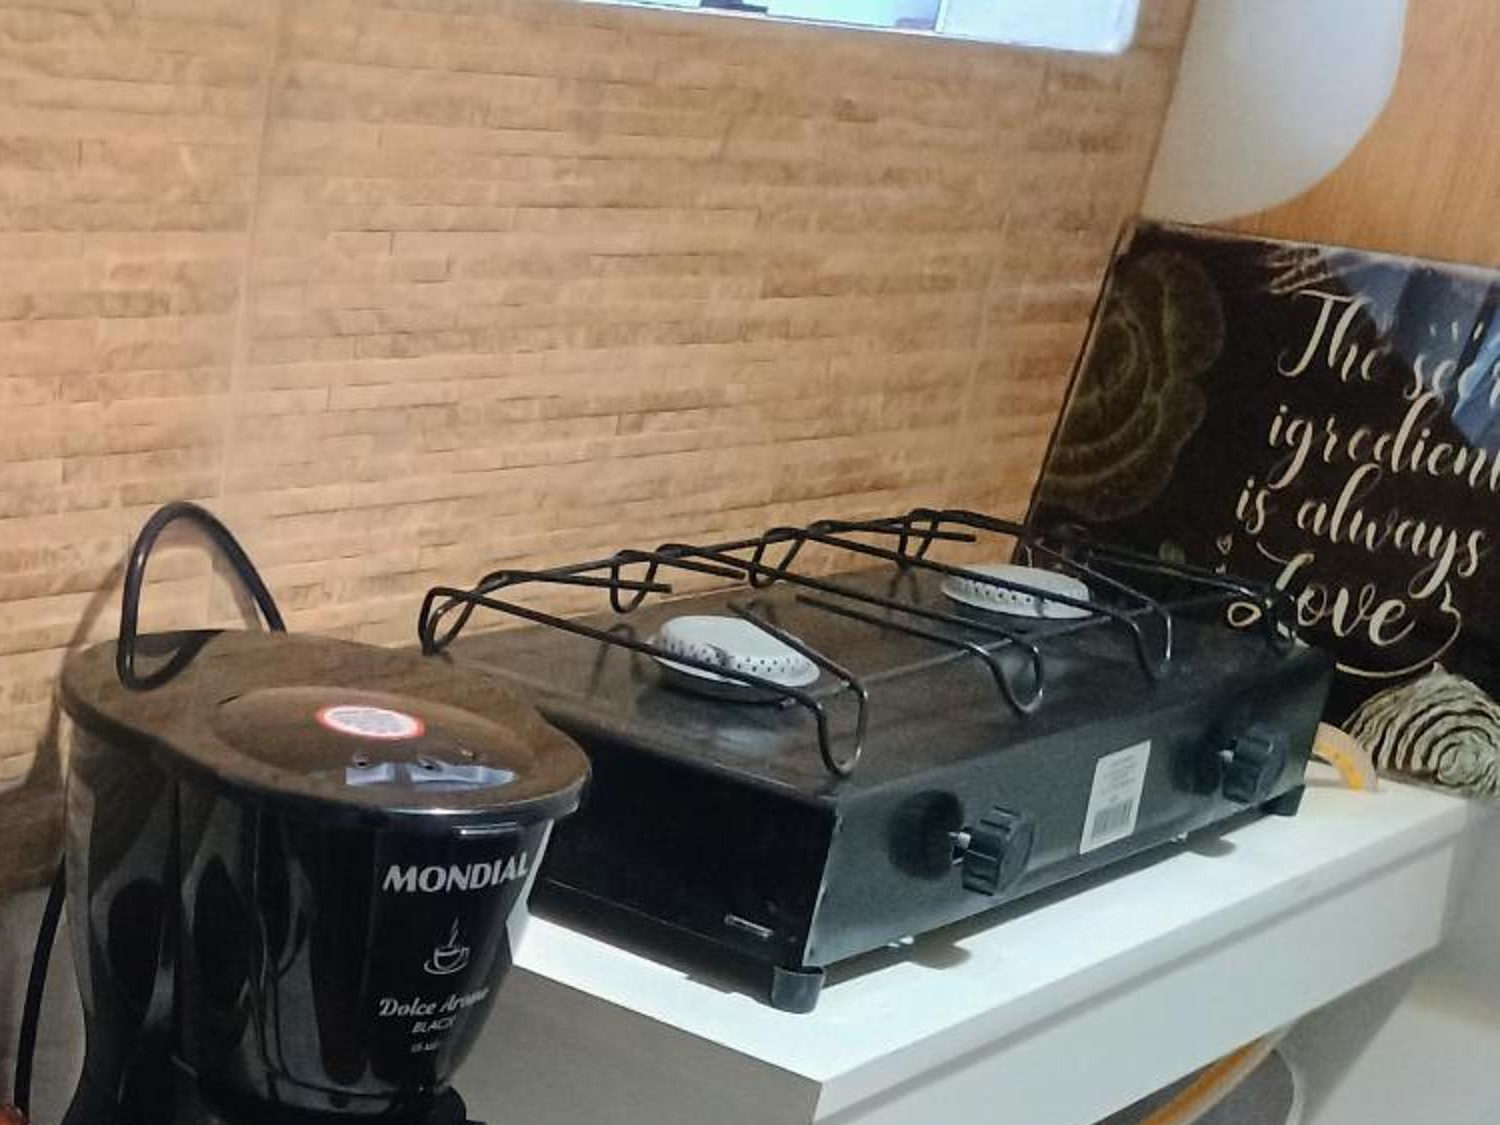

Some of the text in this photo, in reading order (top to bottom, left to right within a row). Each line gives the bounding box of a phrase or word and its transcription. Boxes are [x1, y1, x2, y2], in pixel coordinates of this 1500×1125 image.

[1276, 288, 1389, 383] The
[1236, 463, 1484, 599] is always
[382, 853, 529, 893] MONDIAL
[379, 997, 437, 1017] Dolce
